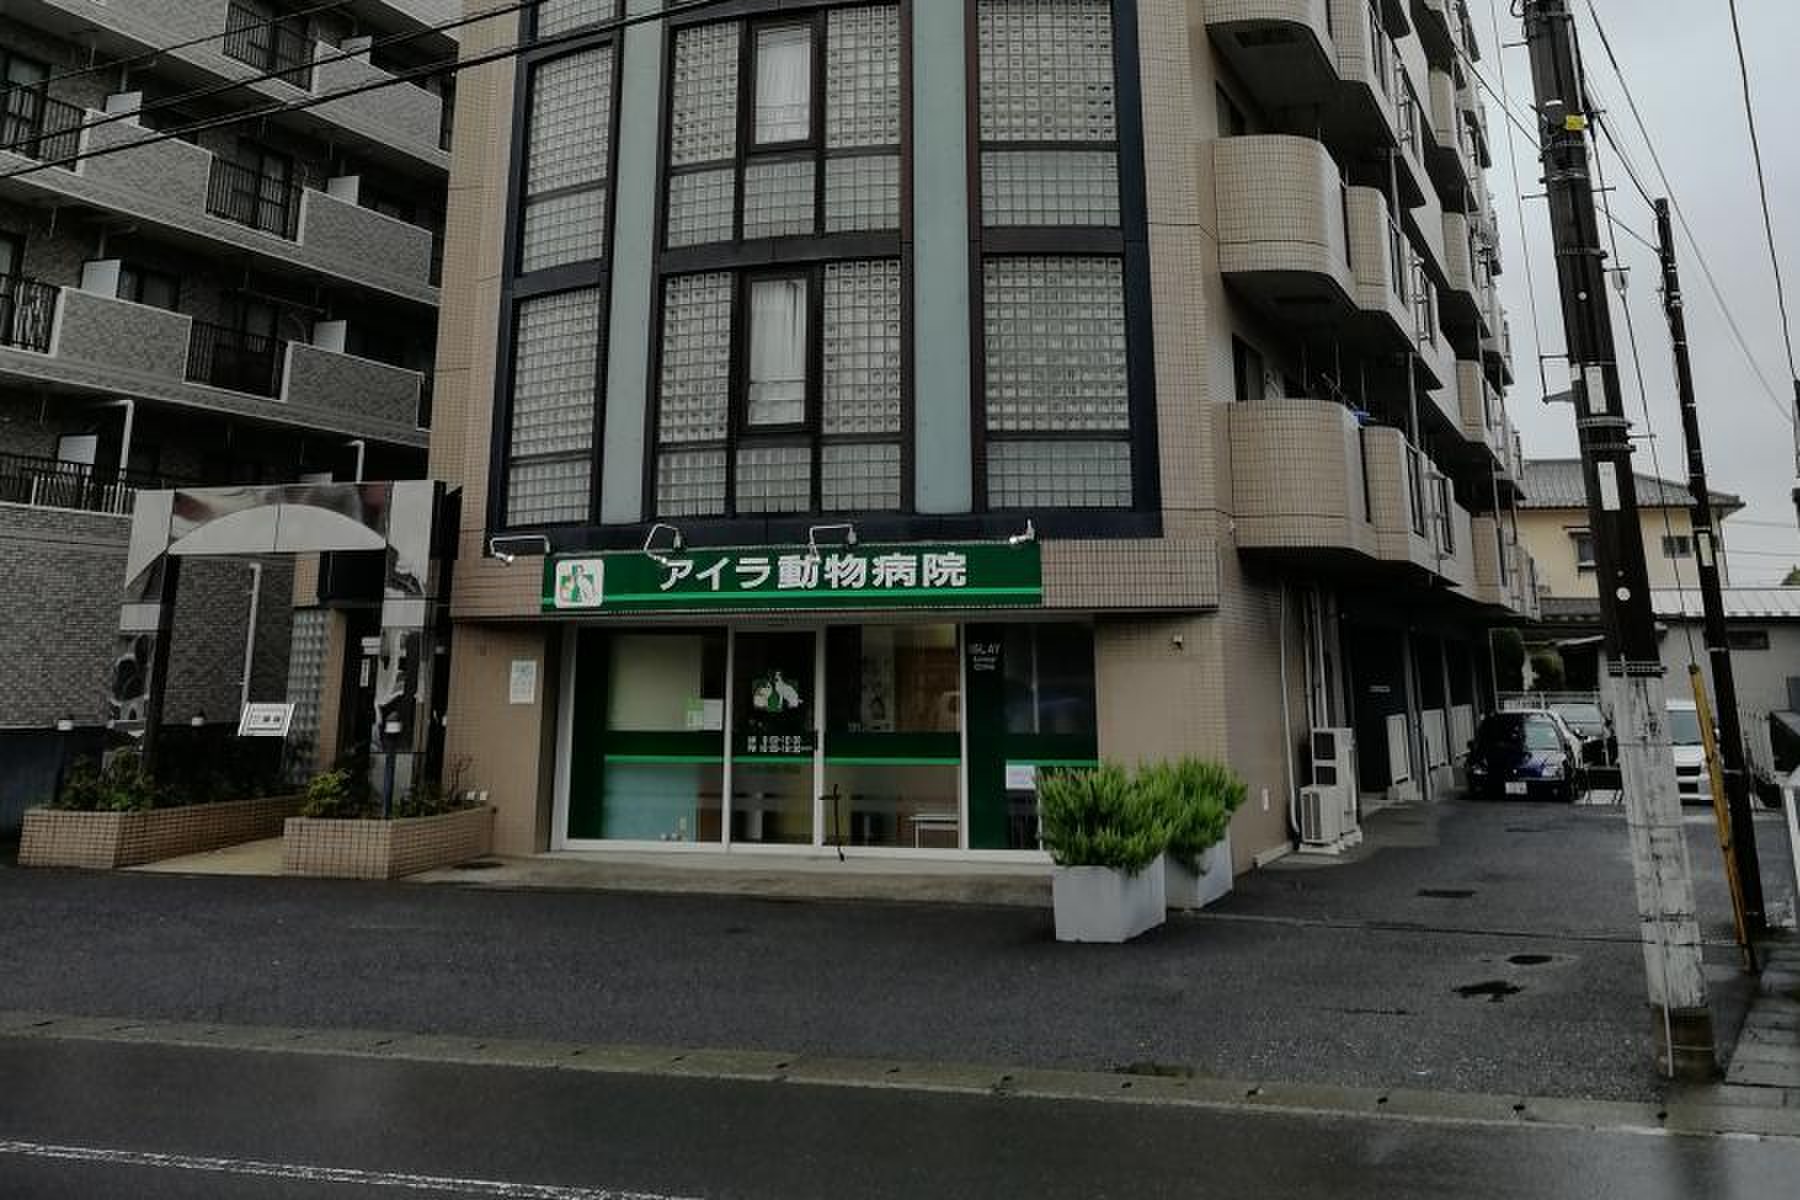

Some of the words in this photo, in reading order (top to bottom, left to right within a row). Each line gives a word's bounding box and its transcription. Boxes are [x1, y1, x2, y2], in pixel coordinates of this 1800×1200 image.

[659, 552, 967, 590] アイラ動物病院
